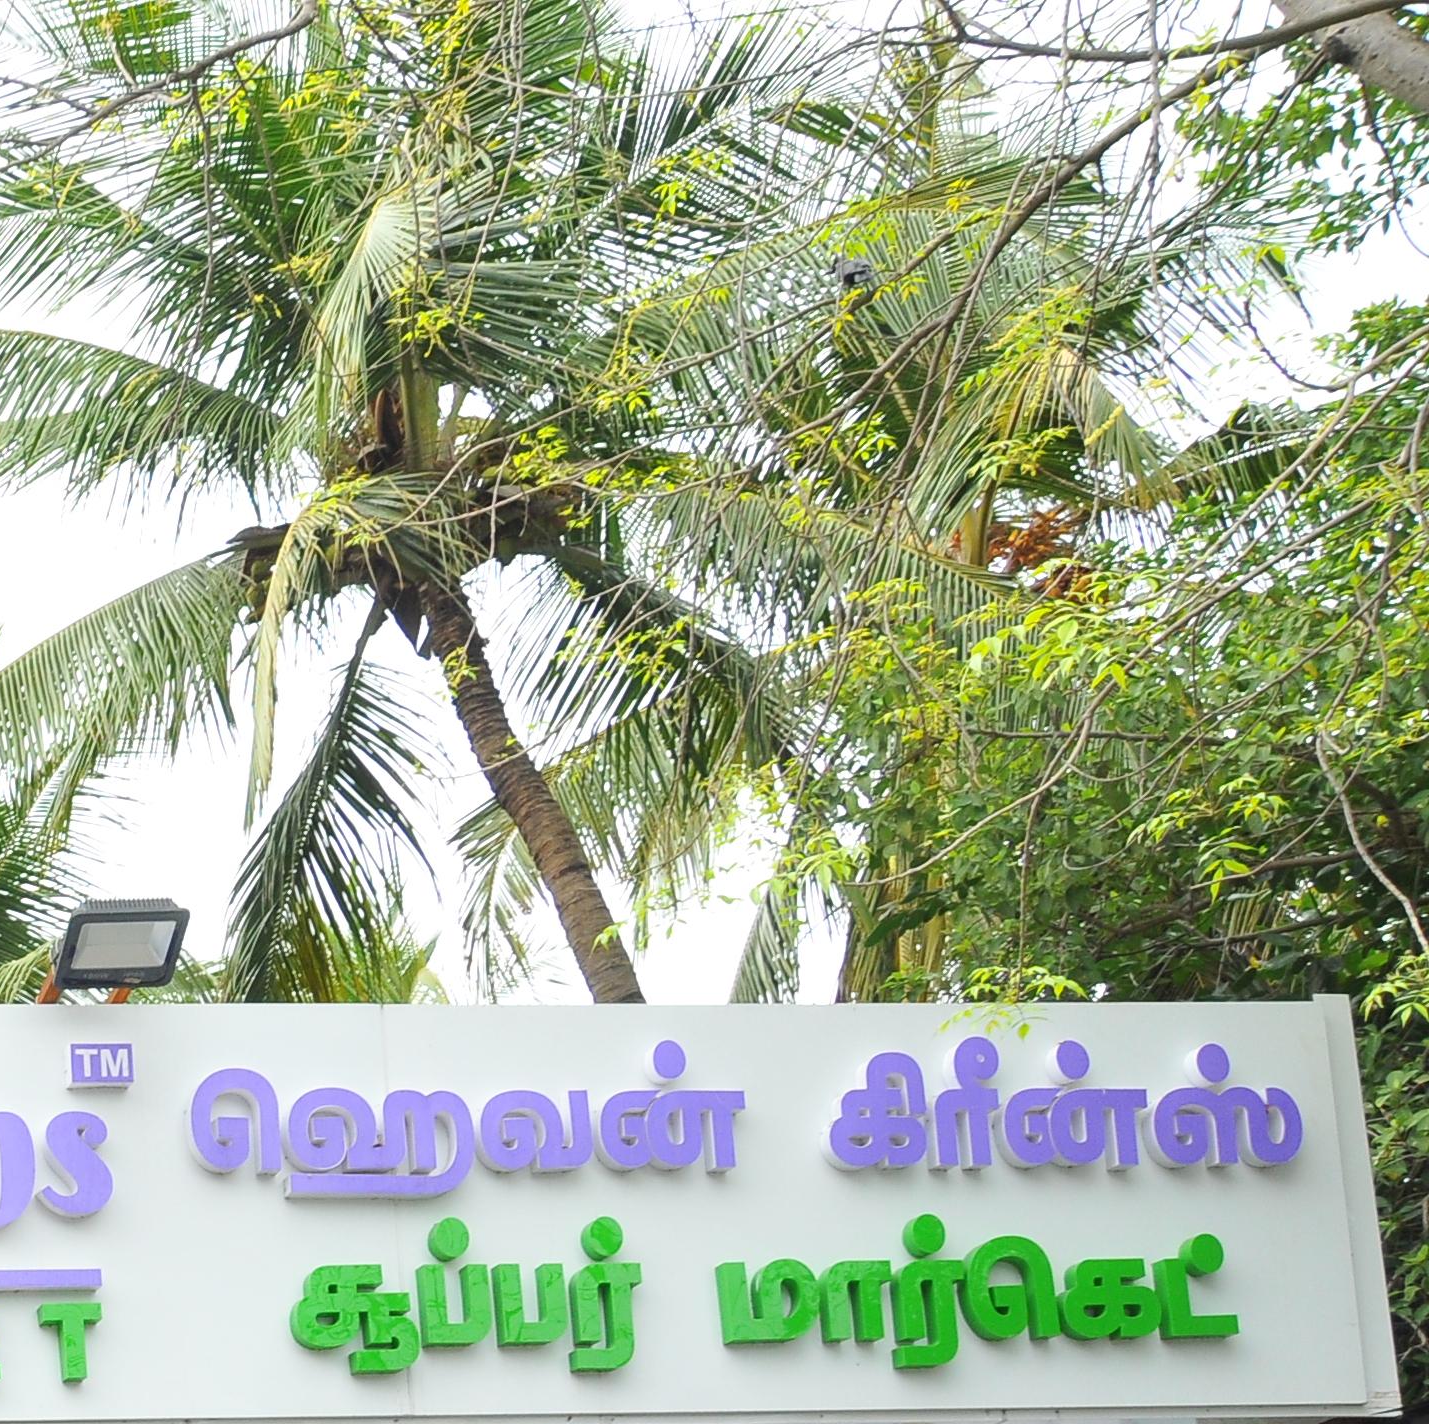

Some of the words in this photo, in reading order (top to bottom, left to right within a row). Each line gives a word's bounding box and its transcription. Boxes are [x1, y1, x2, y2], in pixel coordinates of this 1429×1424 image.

[74, 1047, 132, 1080] TM
[289, 1216, 641, 1376] சூப்பர்
[715, 1213, 1240, 1372] மார்கெட்
